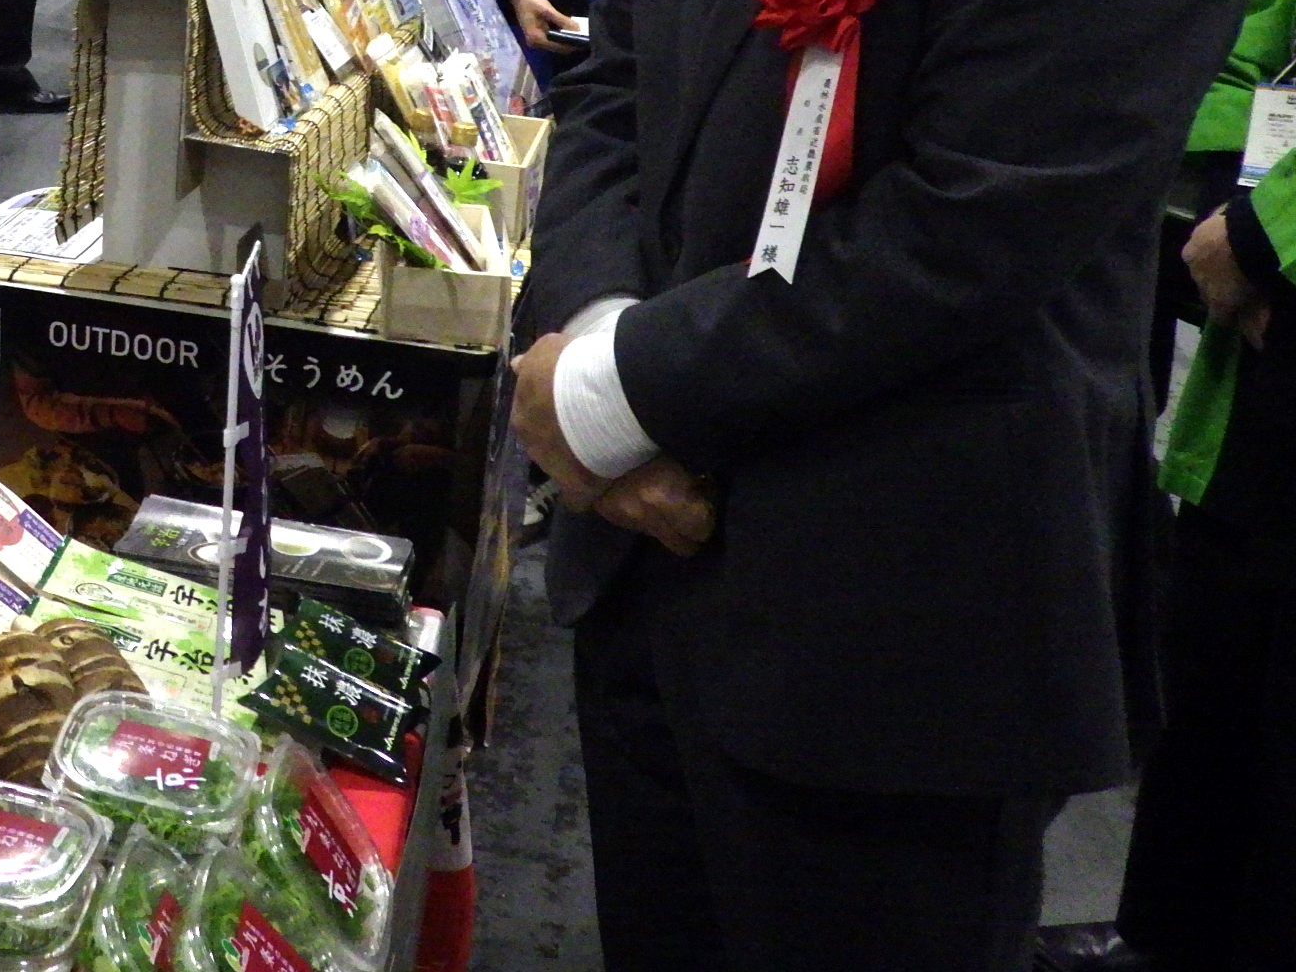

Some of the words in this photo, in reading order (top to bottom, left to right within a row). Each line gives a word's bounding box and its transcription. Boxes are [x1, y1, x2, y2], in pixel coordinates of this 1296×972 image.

[48, 320, 199, 369] OUTDOOR
[264, 352, 404, 401] そうめん
